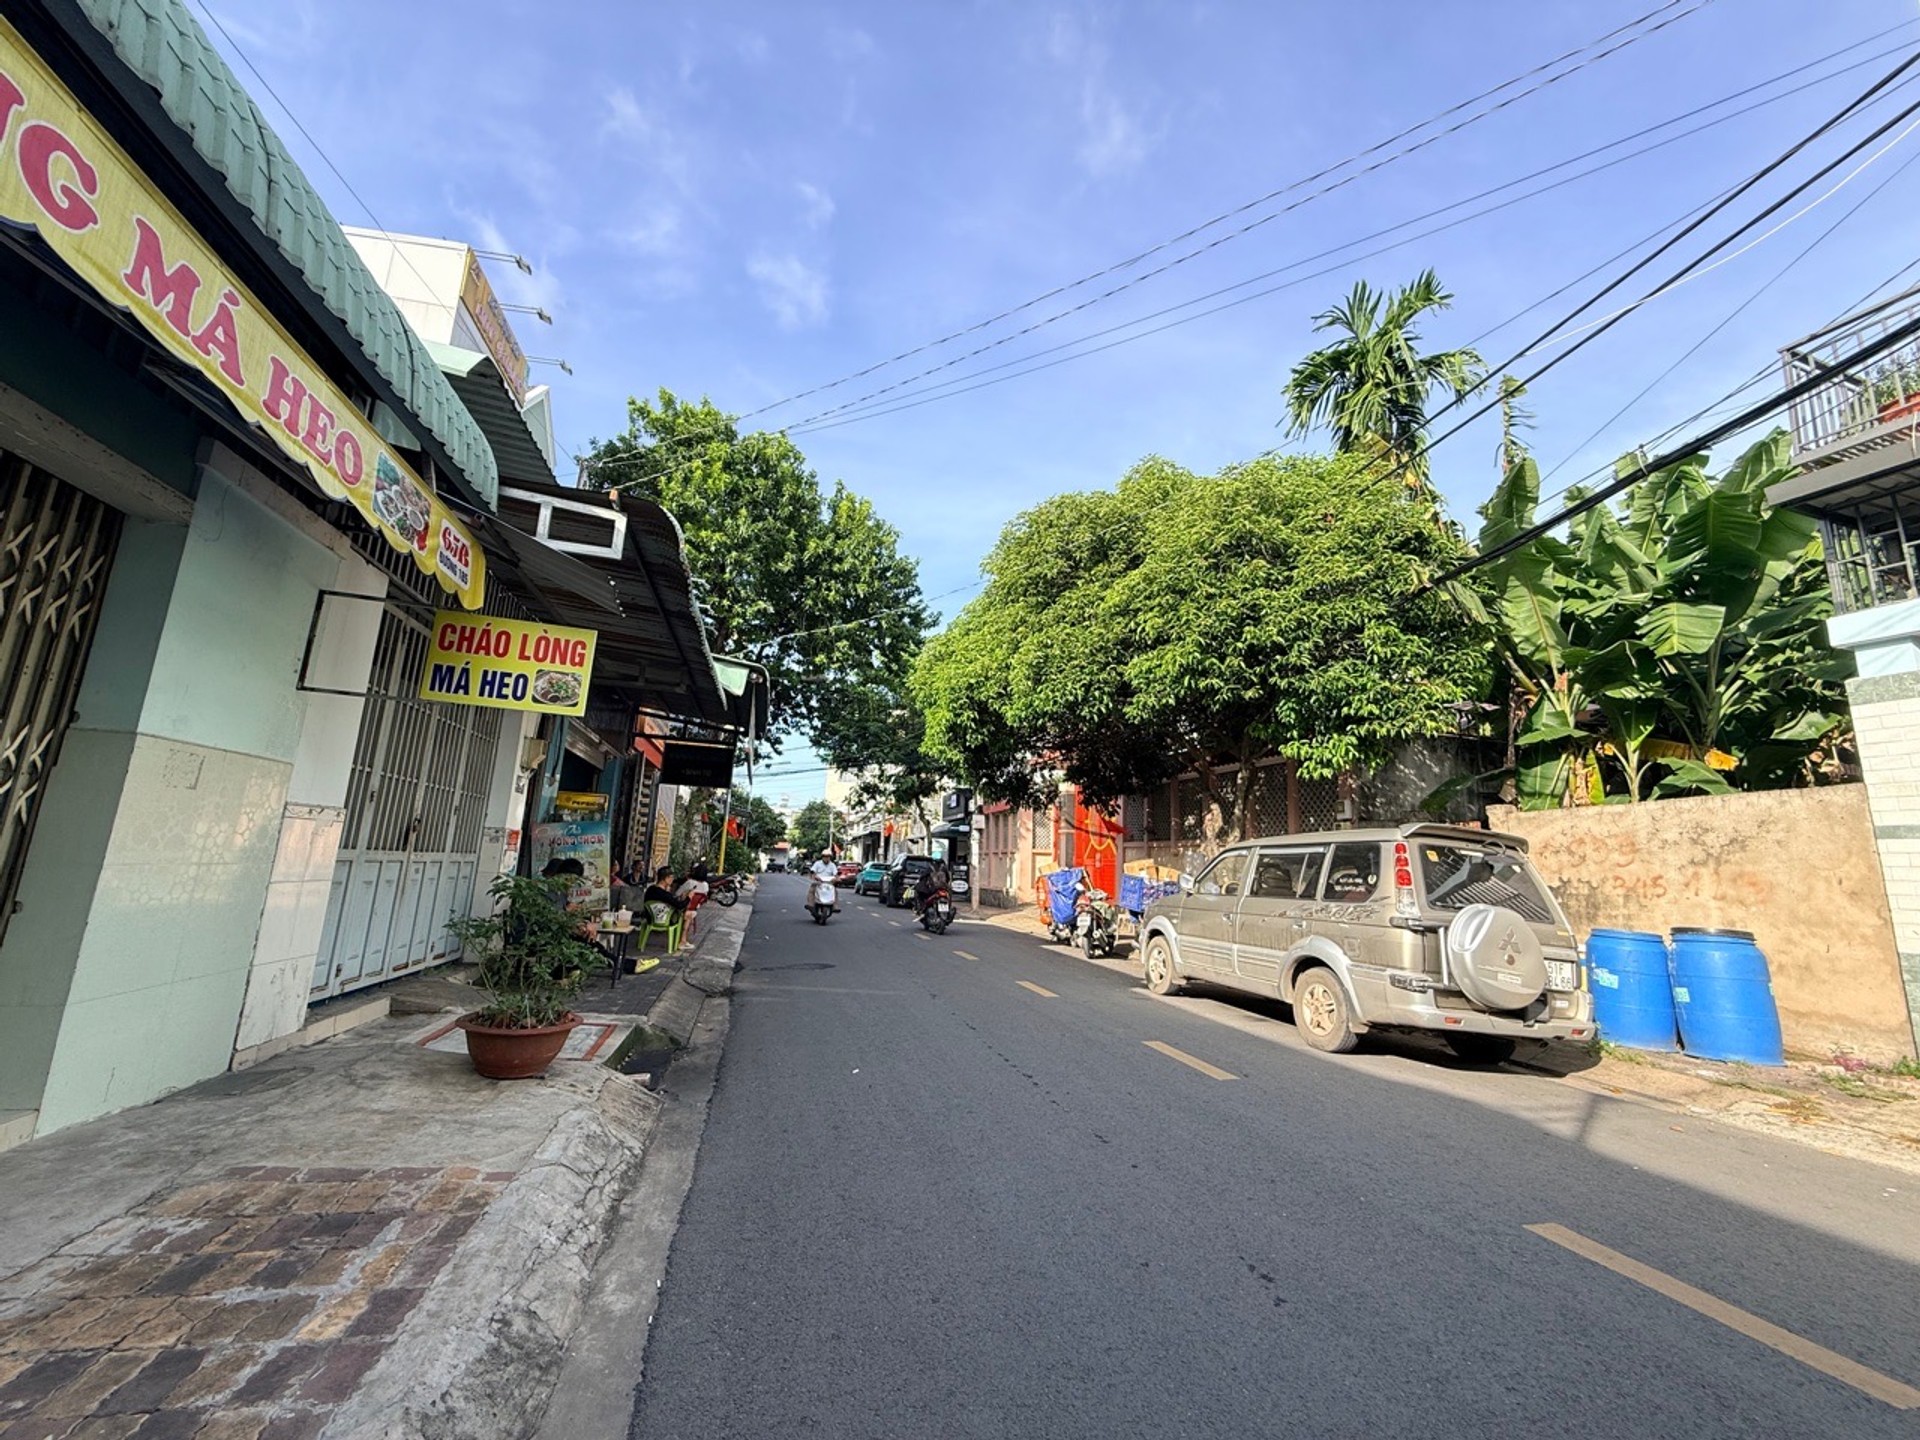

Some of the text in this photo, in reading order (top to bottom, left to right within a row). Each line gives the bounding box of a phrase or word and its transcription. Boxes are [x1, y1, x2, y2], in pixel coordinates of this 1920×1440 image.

[123, 217, 245, 387] MÁ
[262, 355, 363, 486] HEO
[437, 622, 588, 668] CHÁO LÒNG
[428, 661, 529, 702] MÁ HEO
